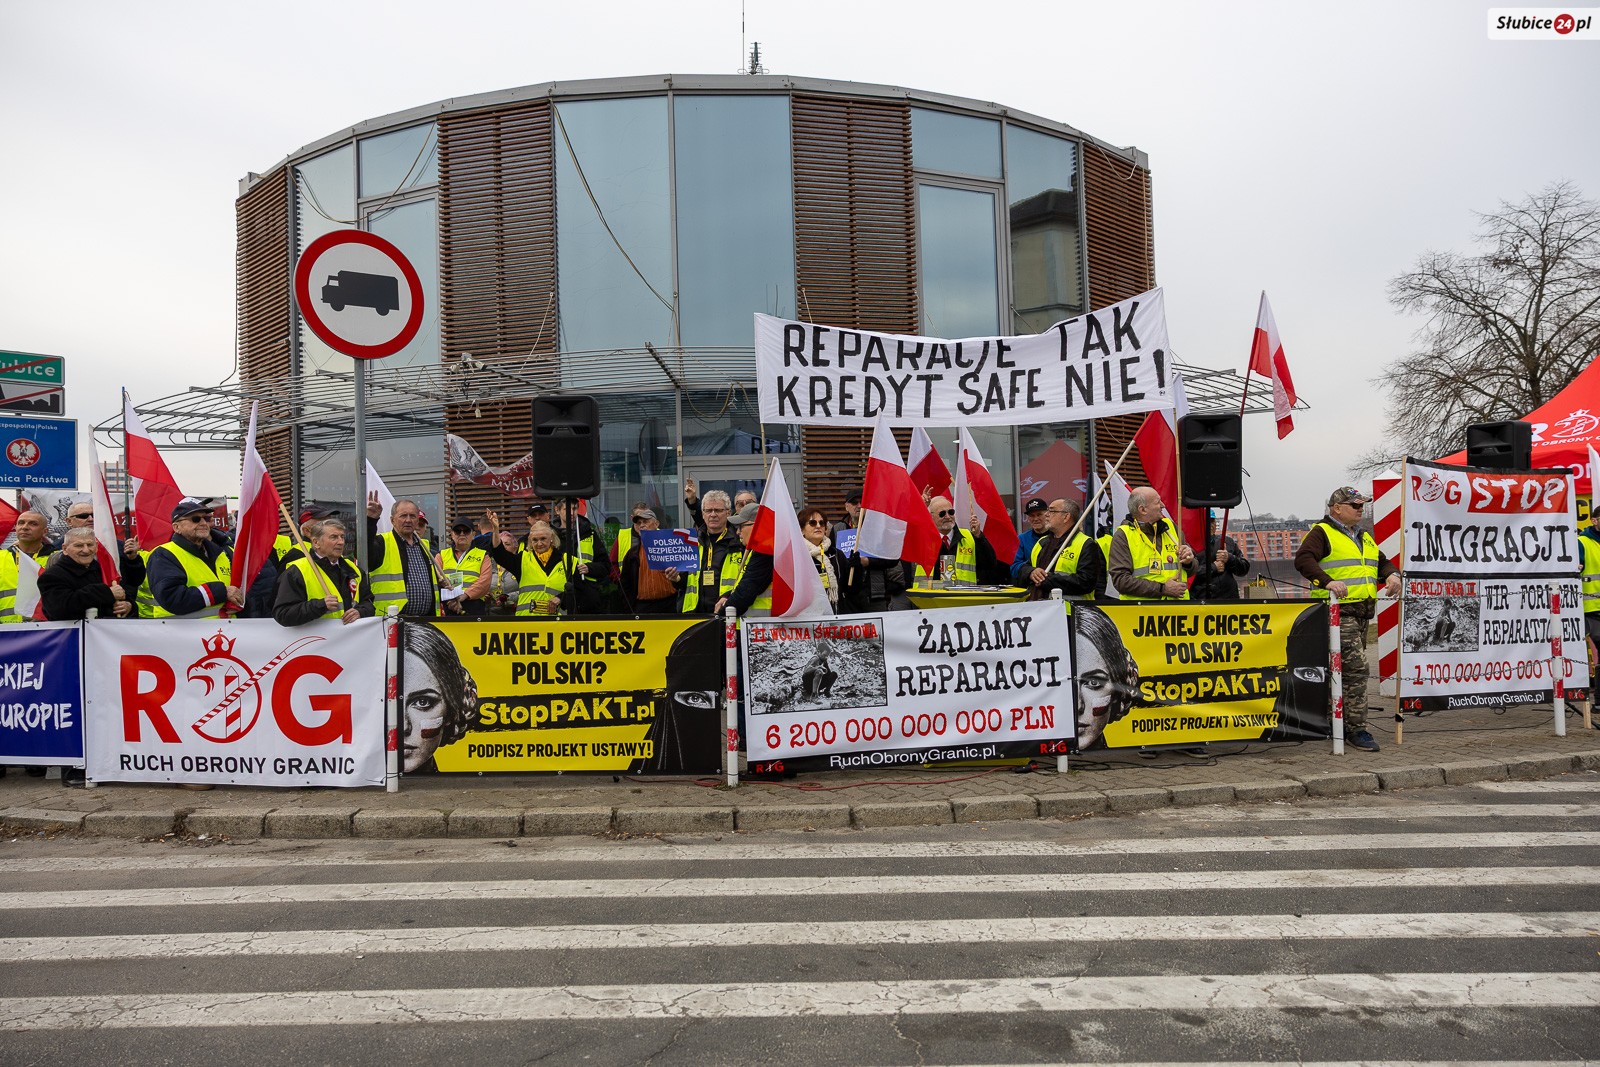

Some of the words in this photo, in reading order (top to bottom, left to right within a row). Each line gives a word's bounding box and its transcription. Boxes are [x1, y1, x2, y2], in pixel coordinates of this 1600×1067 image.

[783, 324, 1017, 373] REPARACJE
[1054, 301, 1141, 362] TAK
[0, 359, 56, 377] ubice
[777, 373, 945, 419] KREDYT
[957, 366, 1045, 416] SAFE
[1541, 436, 1594, 446] OBRONY
[25, 474, 69, 484] Państwa
[491, 476, 534, 492] MYŚLI
[1471, 477, 1566, 510] STOP
[648, 546, 694, 555] BEZPIECZNA
[653, 538, 684, 547] POLSKA
[1410, 521, 1573, 563] IMIGRACJI
[651, 553, 698, 562] SUWERENNA!
[1410, 581, 1442, 596] WORLD
[1444, 581, 1465, 597] WAR
[1466, 582, 1477, 597] II
[1484, 585, 1510, 610] WIR
[1521, 584, 1579, 610] FORRN
[752, 627, 767, 643] II
[769, 627, 811, 641] WOJNA
[814, 623, 879, 640] ŚWIATOWA
[918, 616, 1033, 658] ŻĄDAMY
[1133, 615, 1199, 638] JAKIEJ
[1204, 613, 1273, 636] CHCESZ
[473, 632, 554, 656] JAKIEJ
[560, 631, 646, 655] CHCESZ
[1166, 640, 1243, 665] POLSKI?
[511, 660, 608, 685] POLSKI?
[895, 655, 1062, 698] REPARACJI
[1413, 664, 1424, 686] 1
[1426, 663, 1451, 686] 700
[1454, 662, 1482, 683] 000
[1484, 661, 1512, 682] 000
[1517, 659, 1543, 680] 000
[1139, 672, 1281, 704] StopPAKT.pl
[1448, 691, 1545, 708] RuchObronyGranic.pl
[0, 702, 74, 733] UROPIE
[479, 696, 656, 728] StopPAKT.pl
[1131, 717, 1178, 733] PODPISZ
[1180, 715, 1229, 731] PROJEKT
[1232, 714, 1278, 729] USTAWY!
[765, 724, 782, 749] 6
[789, 720, 837, 748] 200
[845, 716, 893, 743] 000
[901, 712, 947, 738] 000
[955, 708, 1002, 735] 000
[1010, 705, 1055, 731] PLN
[468, 743, 524, 759] PODPISZ
[527, 743, 587, 758] PROJEKT
[591, 742, 652, 758] USTAWY!
[830, 744, 996, 768] RuchObronyGranic.pl
[120, 754, 174, 772] RUCH
[181, 755, 266, 774] OBRONY
[273, 757, 355, 775] GRANIC
